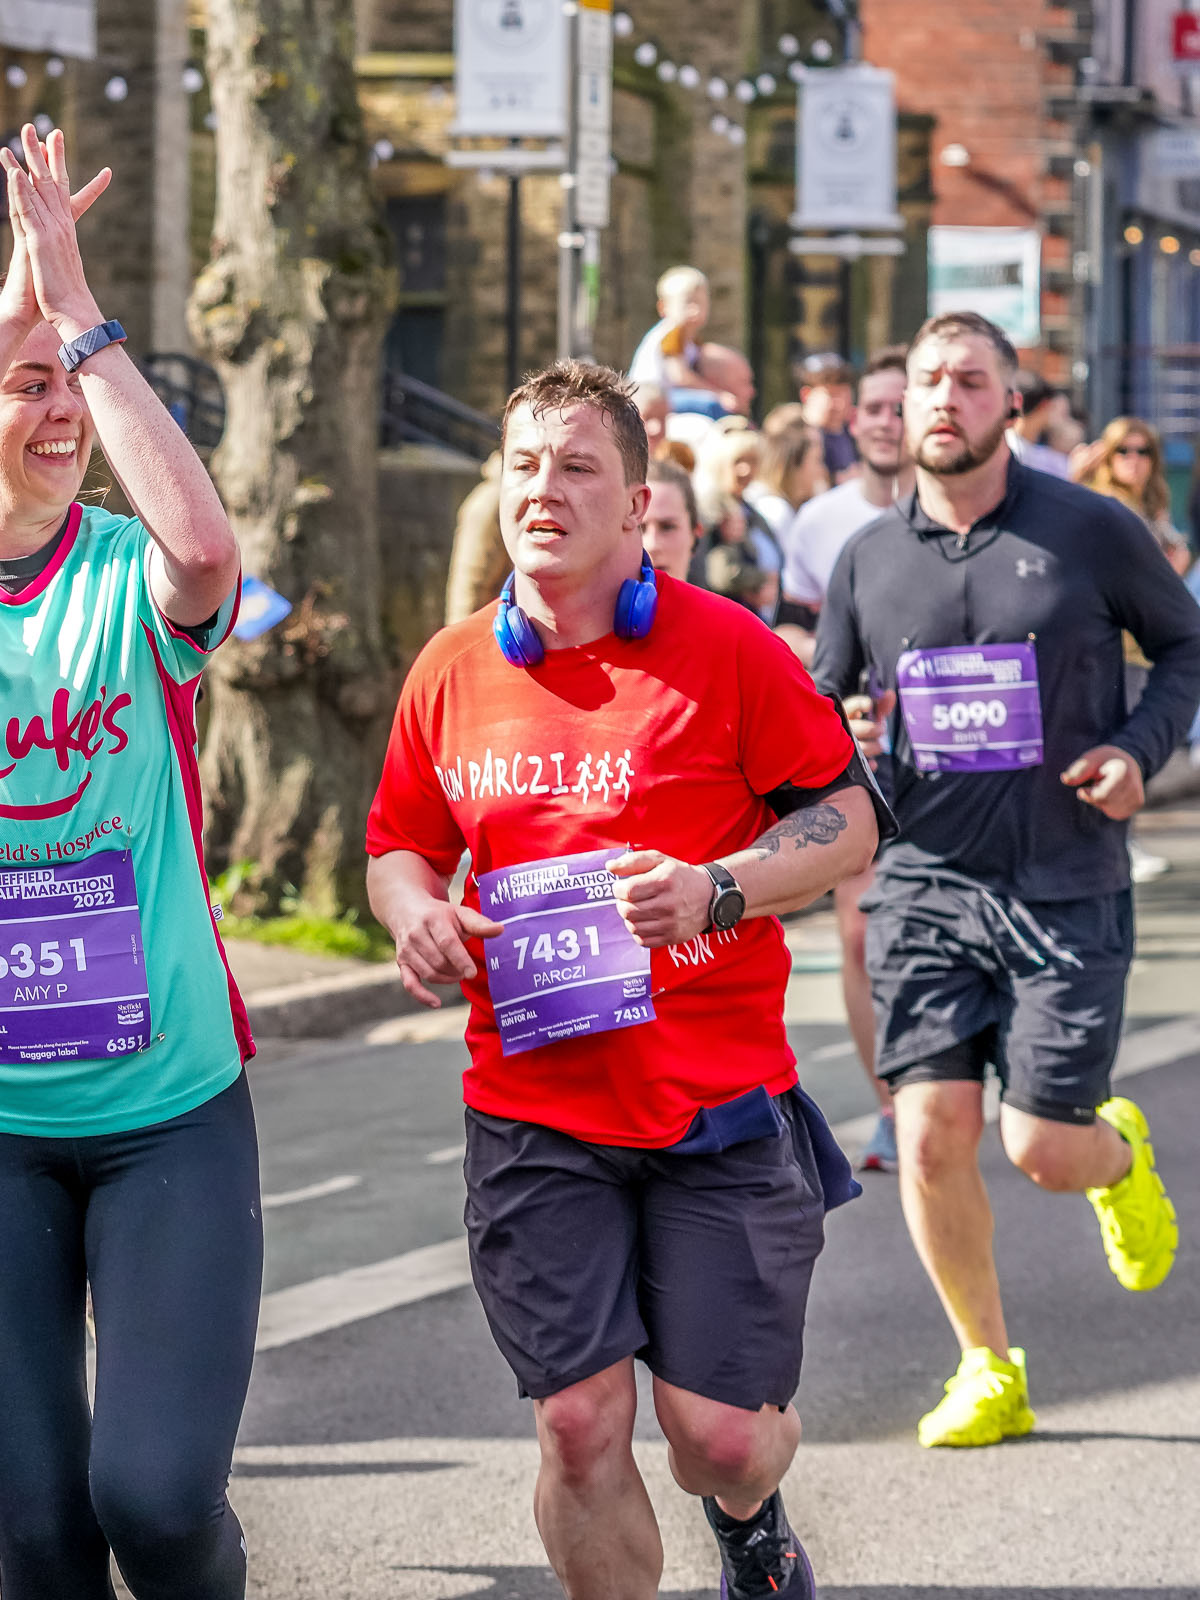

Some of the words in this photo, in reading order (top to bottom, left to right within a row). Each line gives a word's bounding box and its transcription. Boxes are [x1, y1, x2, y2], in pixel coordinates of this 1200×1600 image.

[932, 699, 1008, 731] 5090
[434, 755, 465, 802] RUN
[468, 748, 570, 800] PARCZI
[46, 816, 124, 860] Hospice
[511, 866, 566, 886] SHEFFIELD
[512, 882, 542, 900] HALF
[543, 871, 618, 892] MARATHON
[24, 877, 112, 898] MARATHON
[585, 884, 615, 900] 202
[73, 891, 115, 909] 2022
[513, 926, 601, 970] 7431
[490, 956, 500, 971] M
[533, 964, 587, 988] PARCZI
[13, 984, 52, 1001] AMY
[56, 983, 69, 999] P
[501, 1016, 514, 1027] RUN
[514, 1013, 527, 1024] FOR
[527, 1010, 538, 1020] ALL
[614, 1005, 648, 1023] 7431
[573, 1020, 591, 1032] label
[20, 1050, 57, 1060] Baggage
[58, 1046, 79, 1056] label
[106, 1034, 143, 1053] 6351
